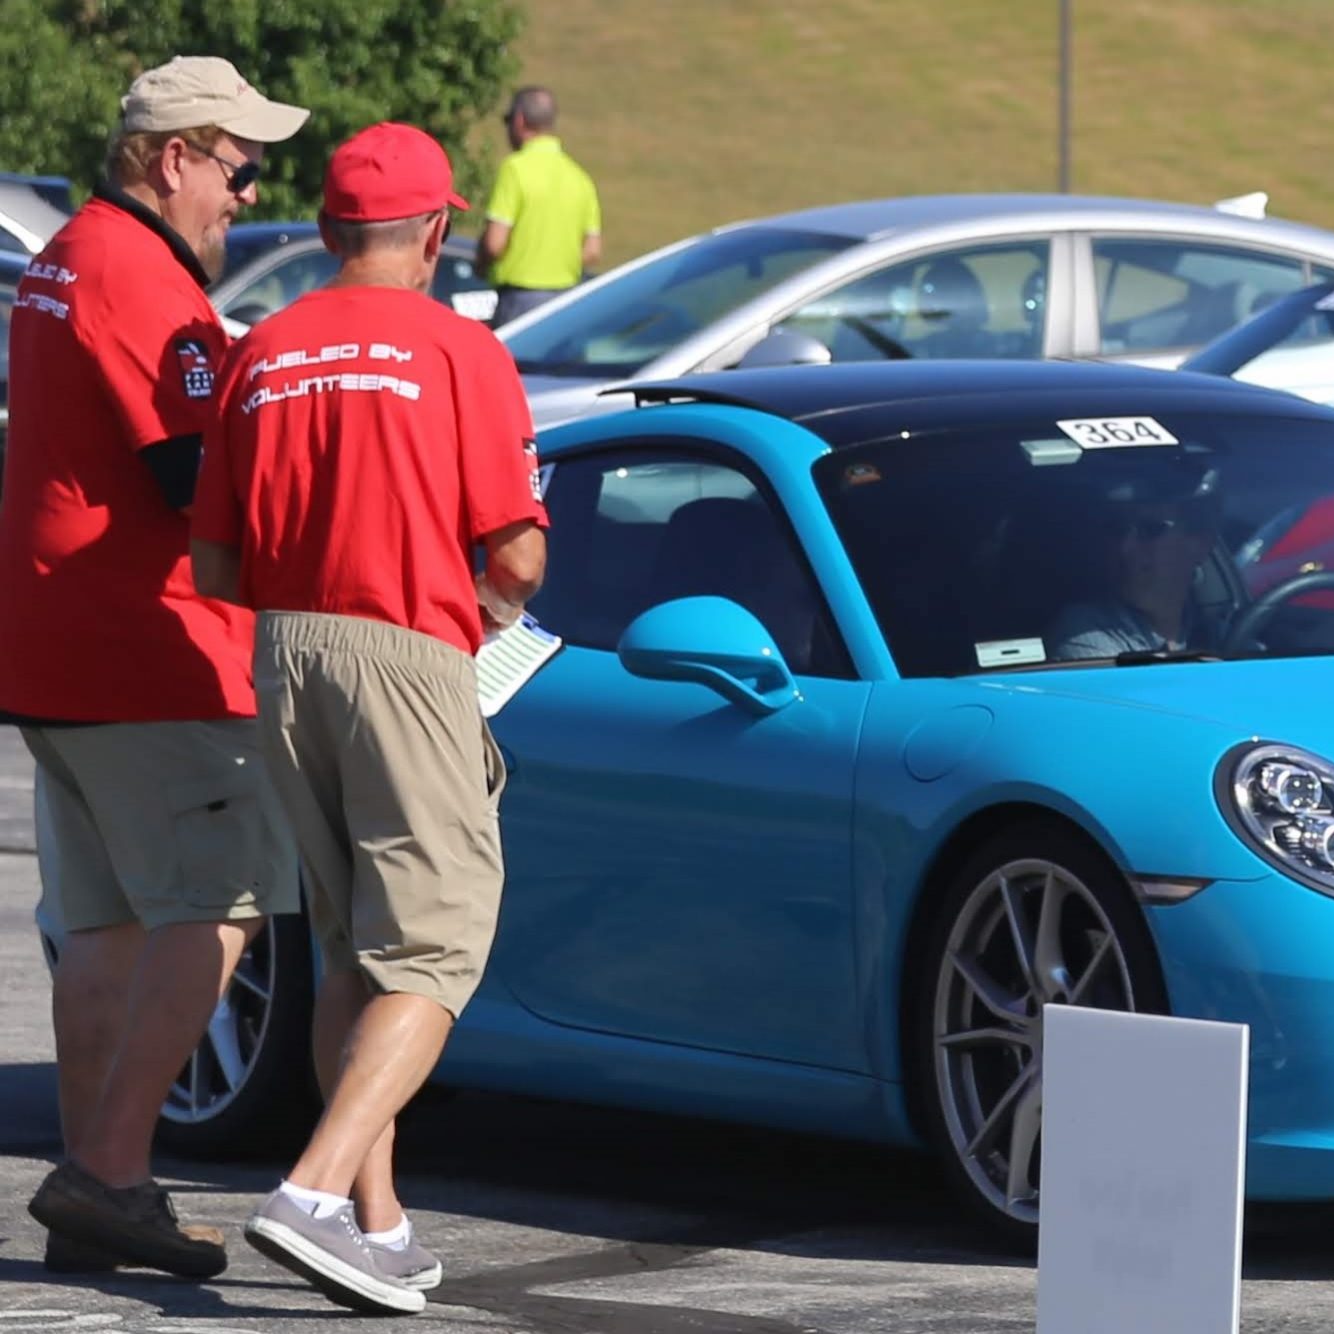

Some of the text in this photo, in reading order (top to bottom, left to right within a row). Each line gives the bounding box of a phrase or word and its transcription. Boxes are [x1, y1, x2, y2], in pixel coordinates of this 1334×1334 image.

[249, 343, 412, 381] FUELED BY
[241, 373, 421, 414] VOLUNTEERS
[1074, 421, 1162, 444] 364
